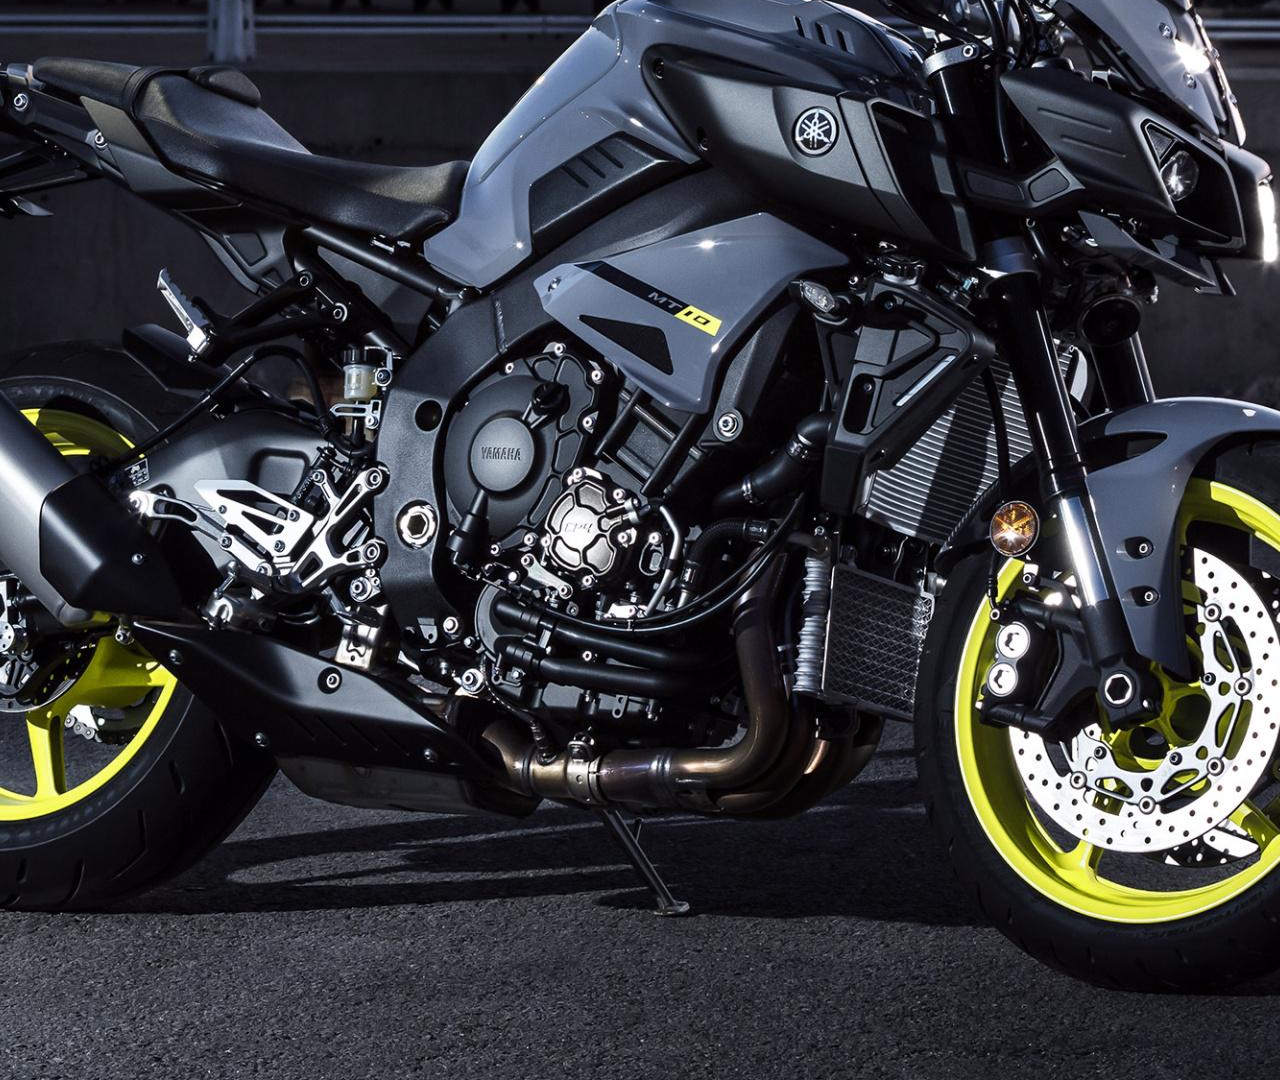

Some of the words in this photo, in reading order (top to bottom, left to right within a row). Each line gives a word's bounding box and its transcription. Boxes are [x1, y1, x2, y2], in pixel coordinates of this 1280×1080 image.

[648, 291, 683, 310] MT
[684, 310, 711, 326] 10
[481, 446, 521, 460] YAMAHA
